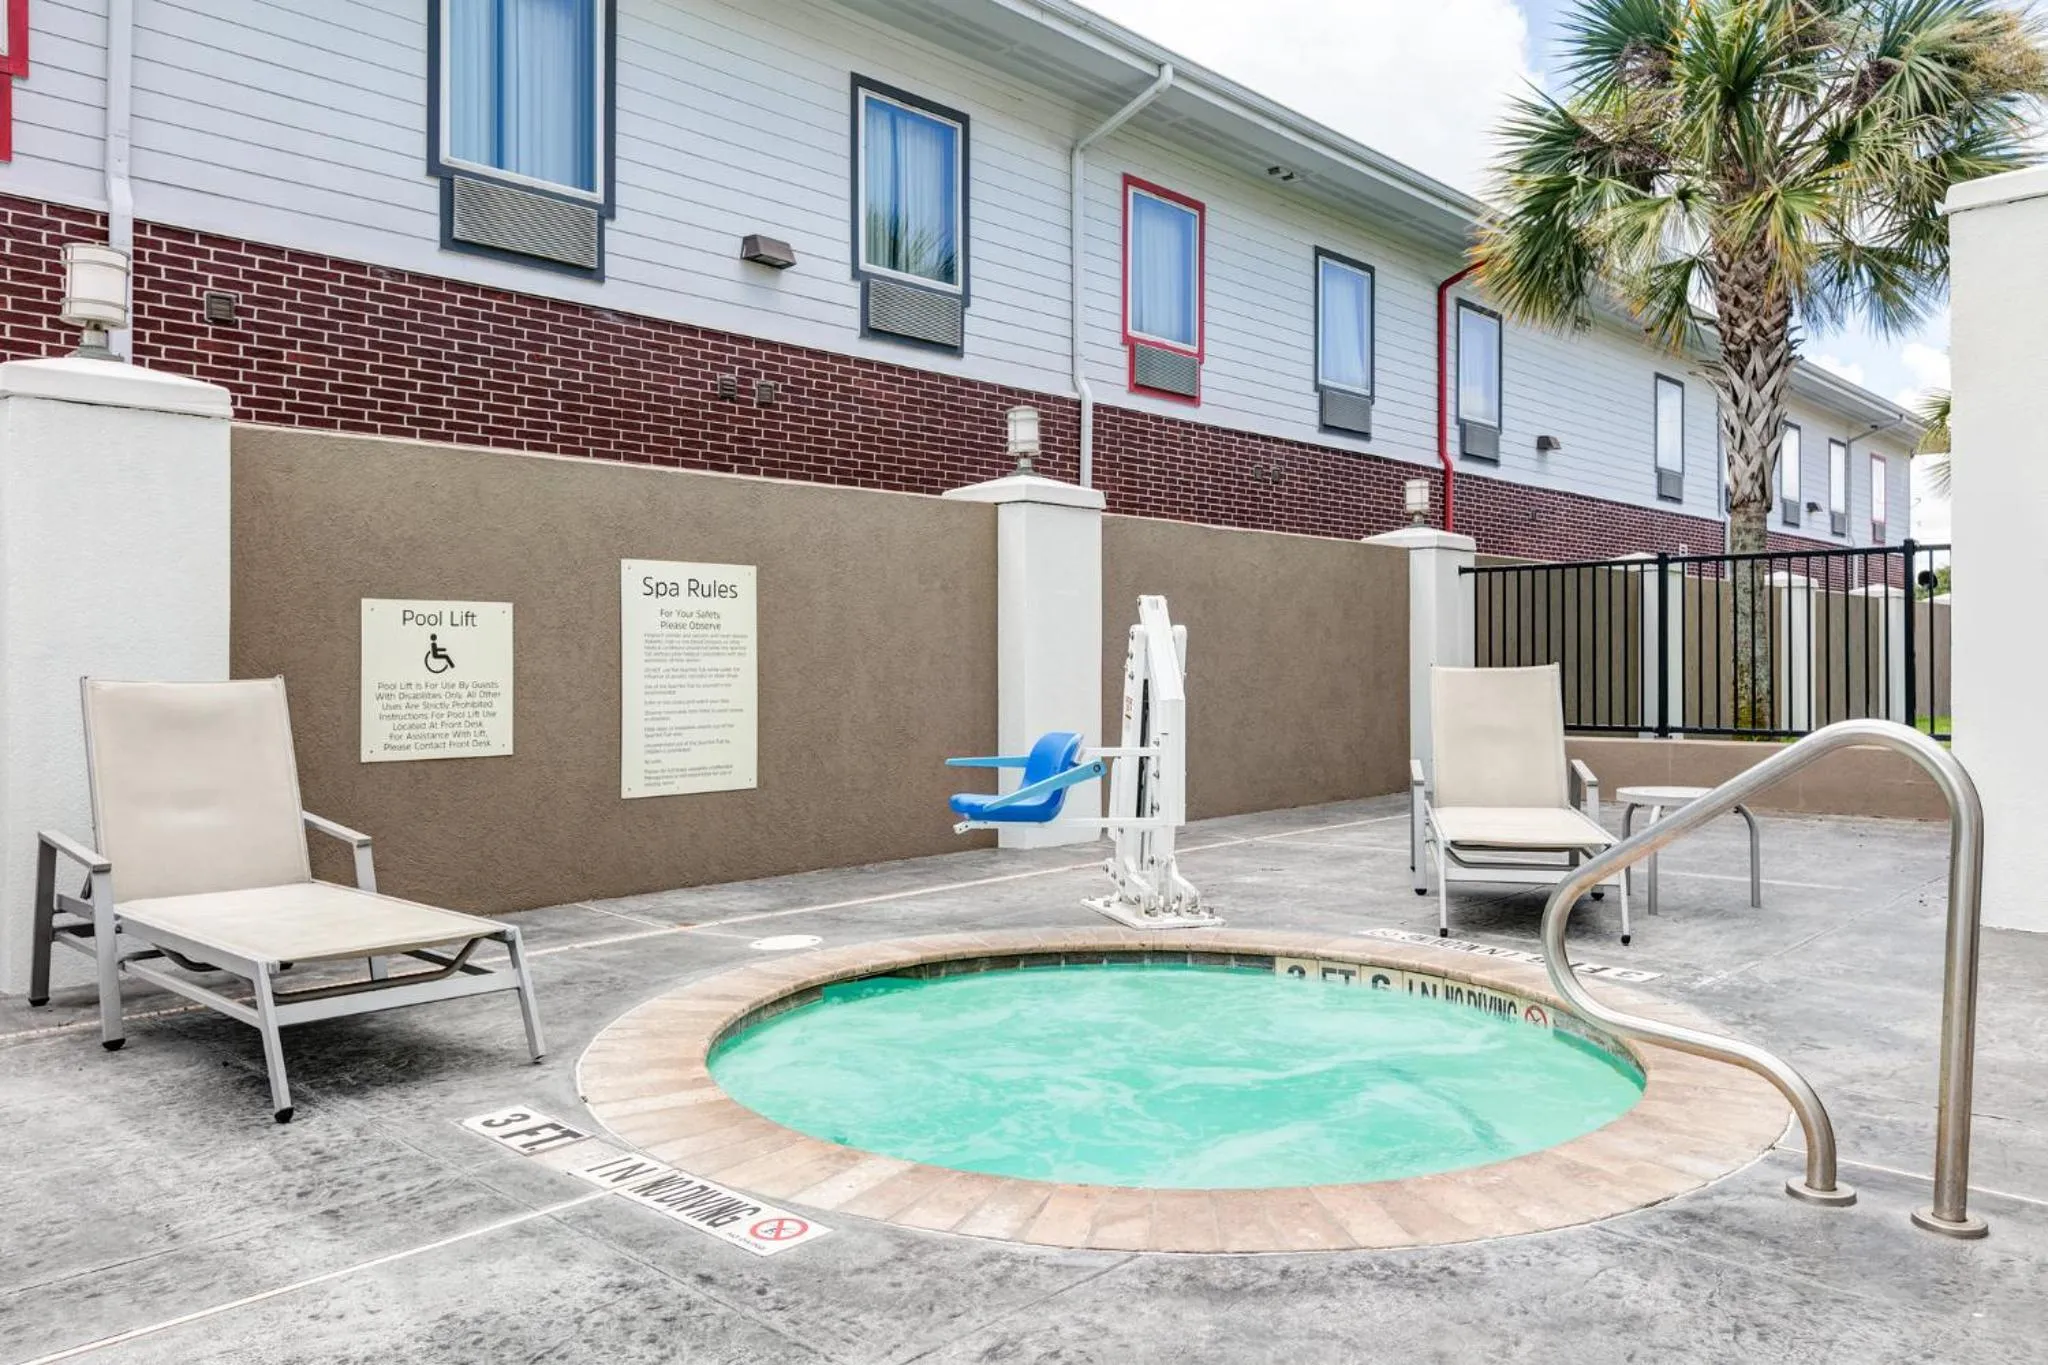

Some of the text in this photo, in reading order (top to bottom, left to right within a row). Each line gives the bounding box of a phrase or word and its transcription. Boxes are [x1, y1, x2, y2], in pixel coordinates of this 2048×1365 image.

[642, 576, 738, 599] Spa Rules
[402, 609, 478, 626] Pool Lift
[660, 608, 673, 617] For
[675, 609, 693, 618] Your
[660, 620, 722, 631] Please Observe
[377, 681, 397, 690] Pool
[400, 681, 413, 690] Lift
[425, 681, 438, 690] For
[441, 681, 456, 690] Use
[459, 681, 469, 690] By
[471, 681, 499, 689] Guests
[375, 692, 395, 701] With
[405, 702, 420, 710] Are
[422, 701, 450, 710] Strictly
[379, 712, 428, 721] Instructions
[431, 711, 445, 719] For
[447, 710, 465, 719] Pool
[467, 710, 480, 718] Lift
[393, 722, 426, 731] Located
[440, 721, 462, 729] Front
[389, 732, 403, 741] For
[406, 731, 450, 740] Assistance
[452, 730, 471, 739] With
[383, 743, 411, 751] Please
[414, 742, 446, 750] Contact
[449, 740, 469, 749] Front
[481, 1112, 531, 1129] 3
[586, 1157, 659, 1184] IN
[653, 1184, 762, 1228] DIVING
